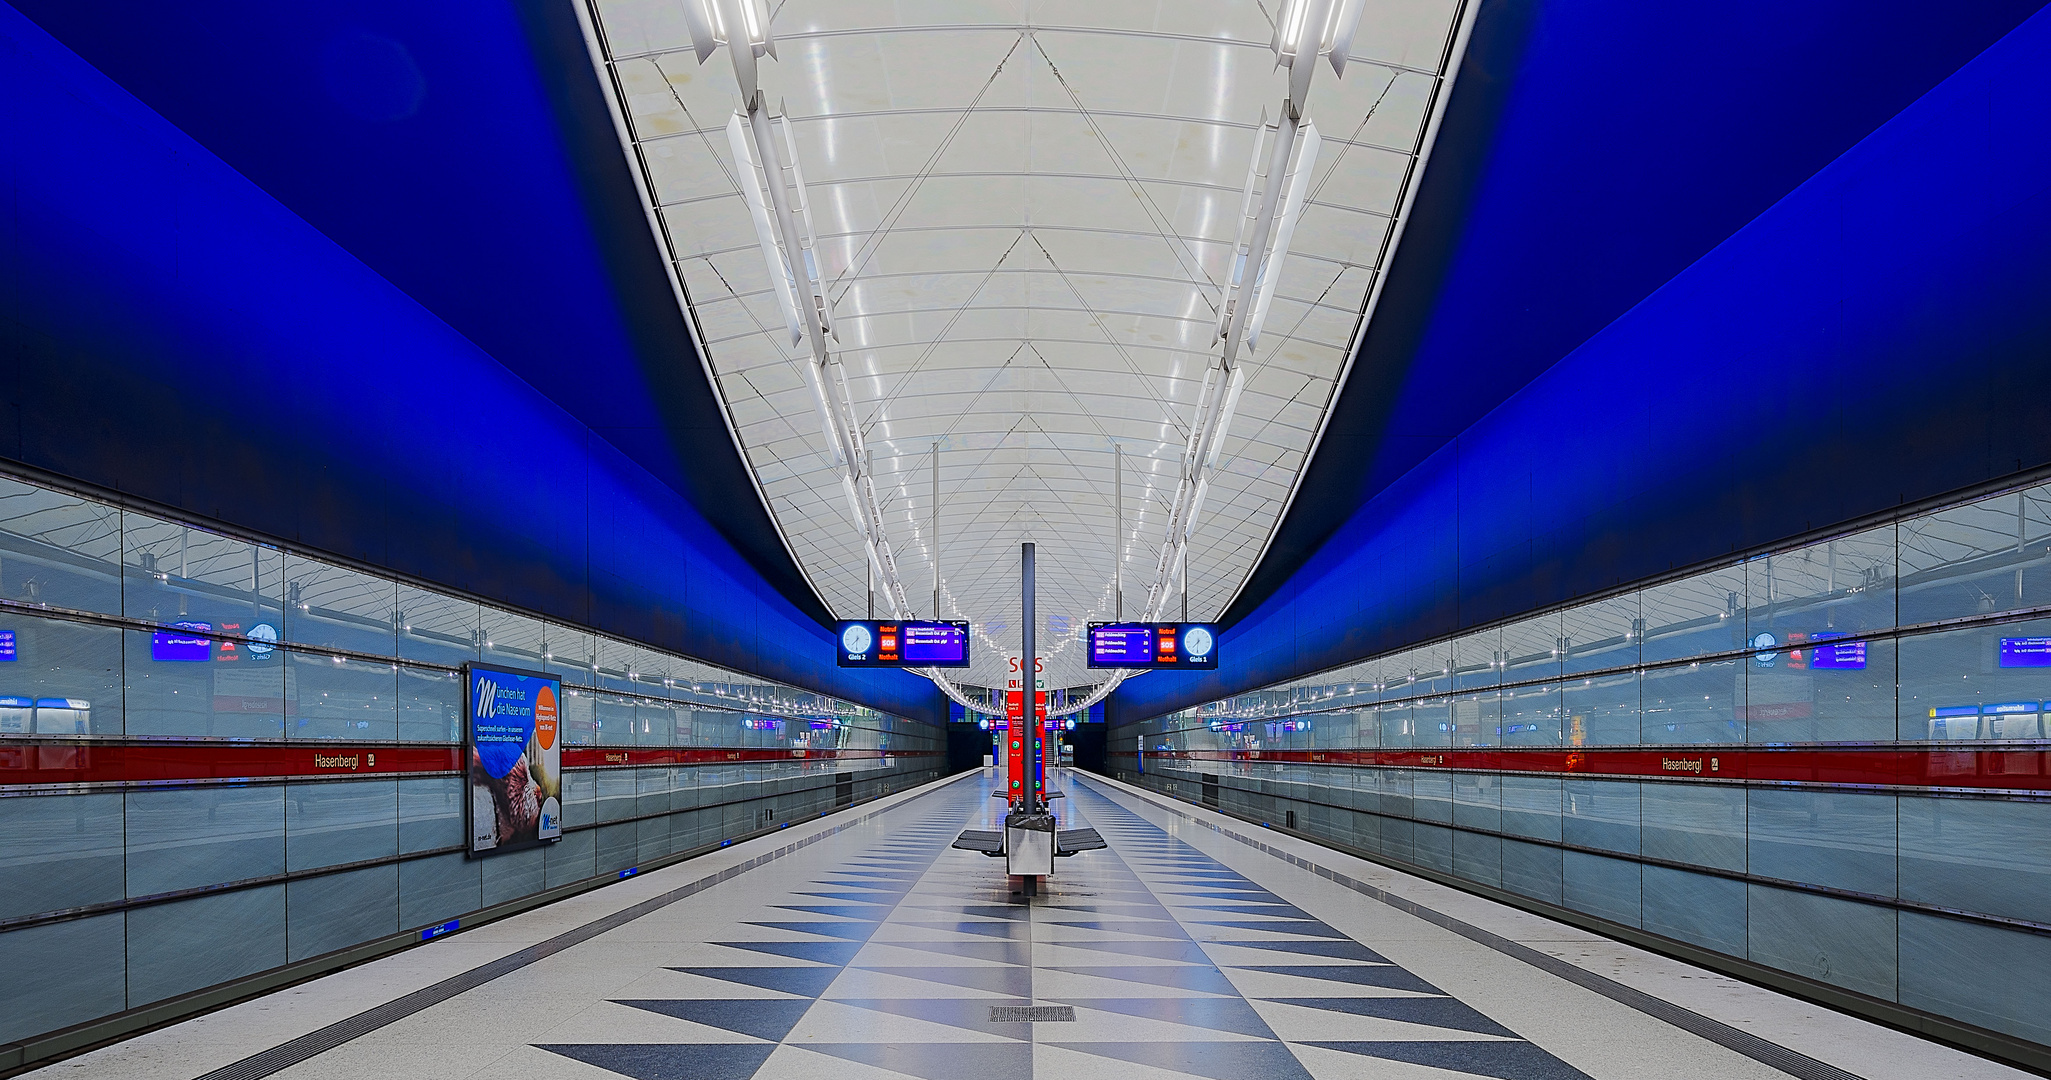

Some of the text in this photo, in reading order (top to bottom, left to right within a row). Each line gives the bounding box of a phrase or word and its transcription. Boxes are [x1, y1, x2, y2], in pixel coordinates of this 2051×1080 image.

[516, 688, 526, 700] hat
[496, 702, 531, 716] die Nase vorn
[315, 754, 359, 770] Hasenbergl
[1662, 757, 1702, 774] Hasenbergl
